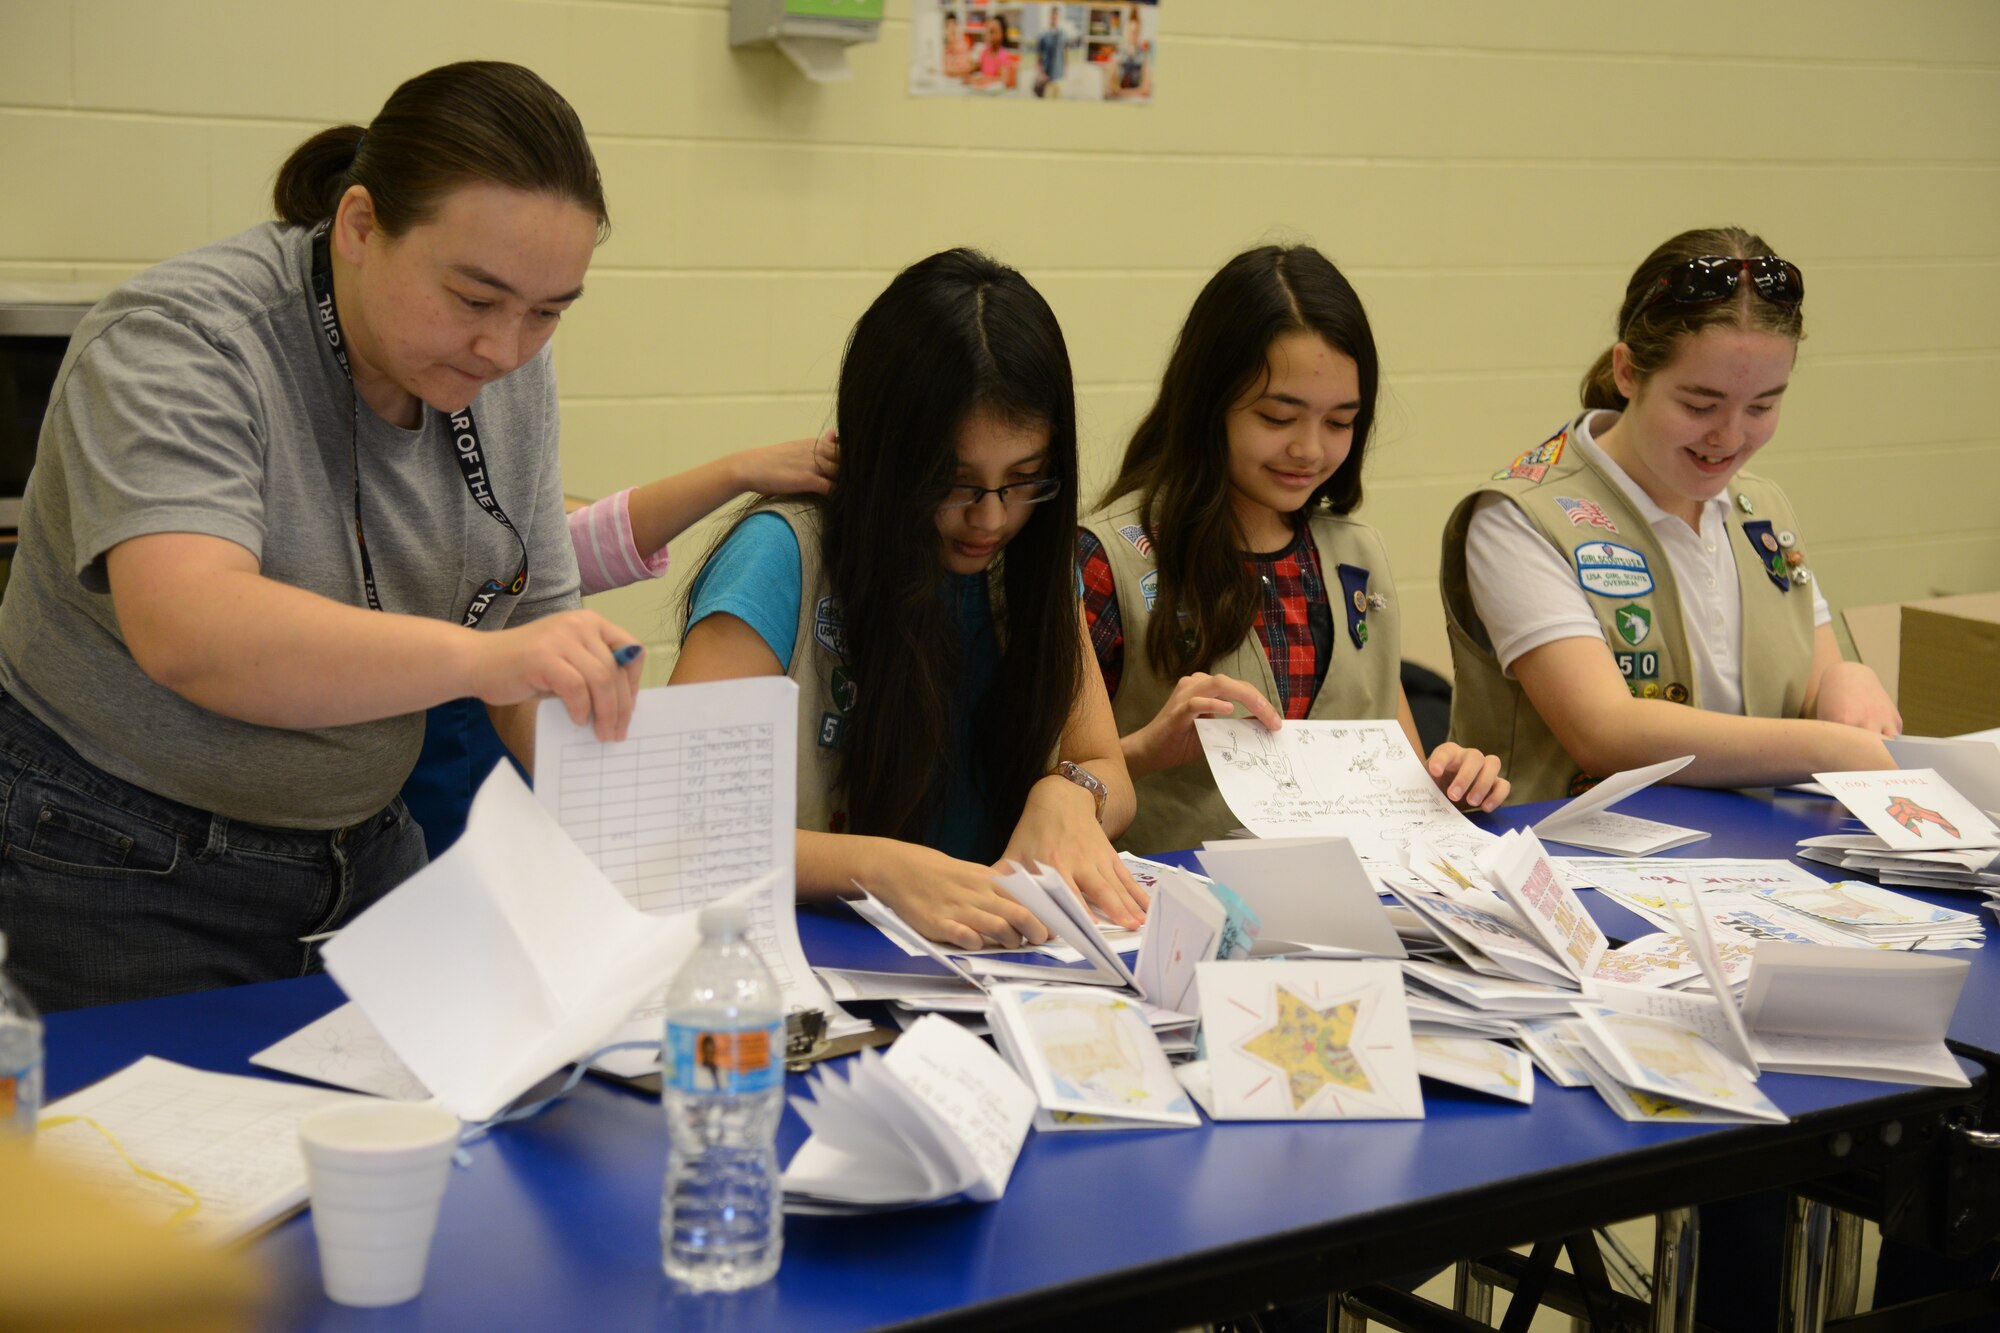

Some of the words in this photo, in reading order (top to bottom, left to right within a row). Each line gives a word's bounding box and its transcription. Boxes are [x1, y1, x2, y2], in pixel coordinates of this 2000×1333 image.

[318, 293, 341, 346] GIRL
[457, 434, 480, 465] OF
[466, 468, 493, 508] THE
[366, 574, 381, 611] IRL
[1145, 583, 1158, 592] GIR
[465, 592, 496, 628] YEA
[822, 717, 838, 743] 5
[1699, 876, 1791, 885] THANK
[1720, 919, 1782, 940] YOU
